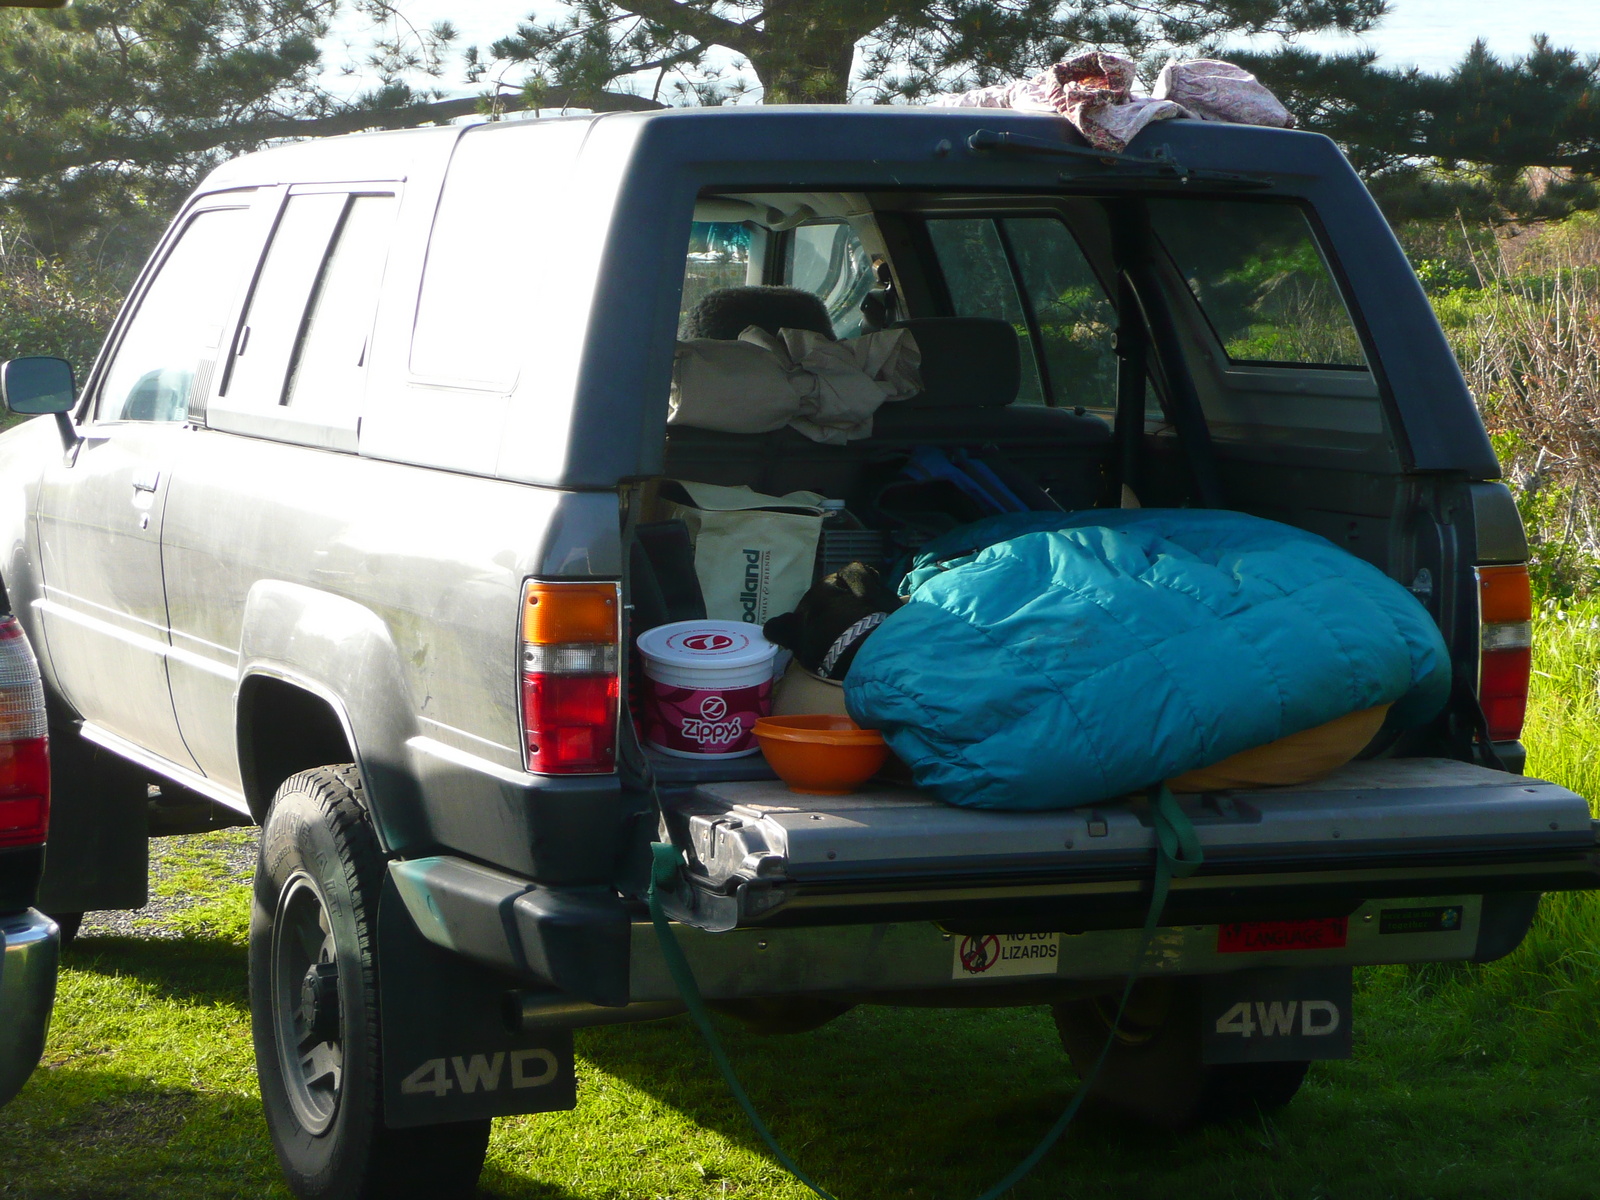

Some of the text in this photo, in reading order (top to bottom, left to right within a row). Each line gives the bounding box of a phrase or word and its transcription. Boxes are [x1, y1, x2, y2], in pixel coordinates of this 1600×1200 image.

[682, 717, 742, 744] Zippy's
[1244, 927, 1324, 947] LANGUAGE
[1002, 944, 1057, 960] LIZARDS
[1216, 1000, 1340, 1037] 4WD
[401, 1048, 559, 1096] 4WD
